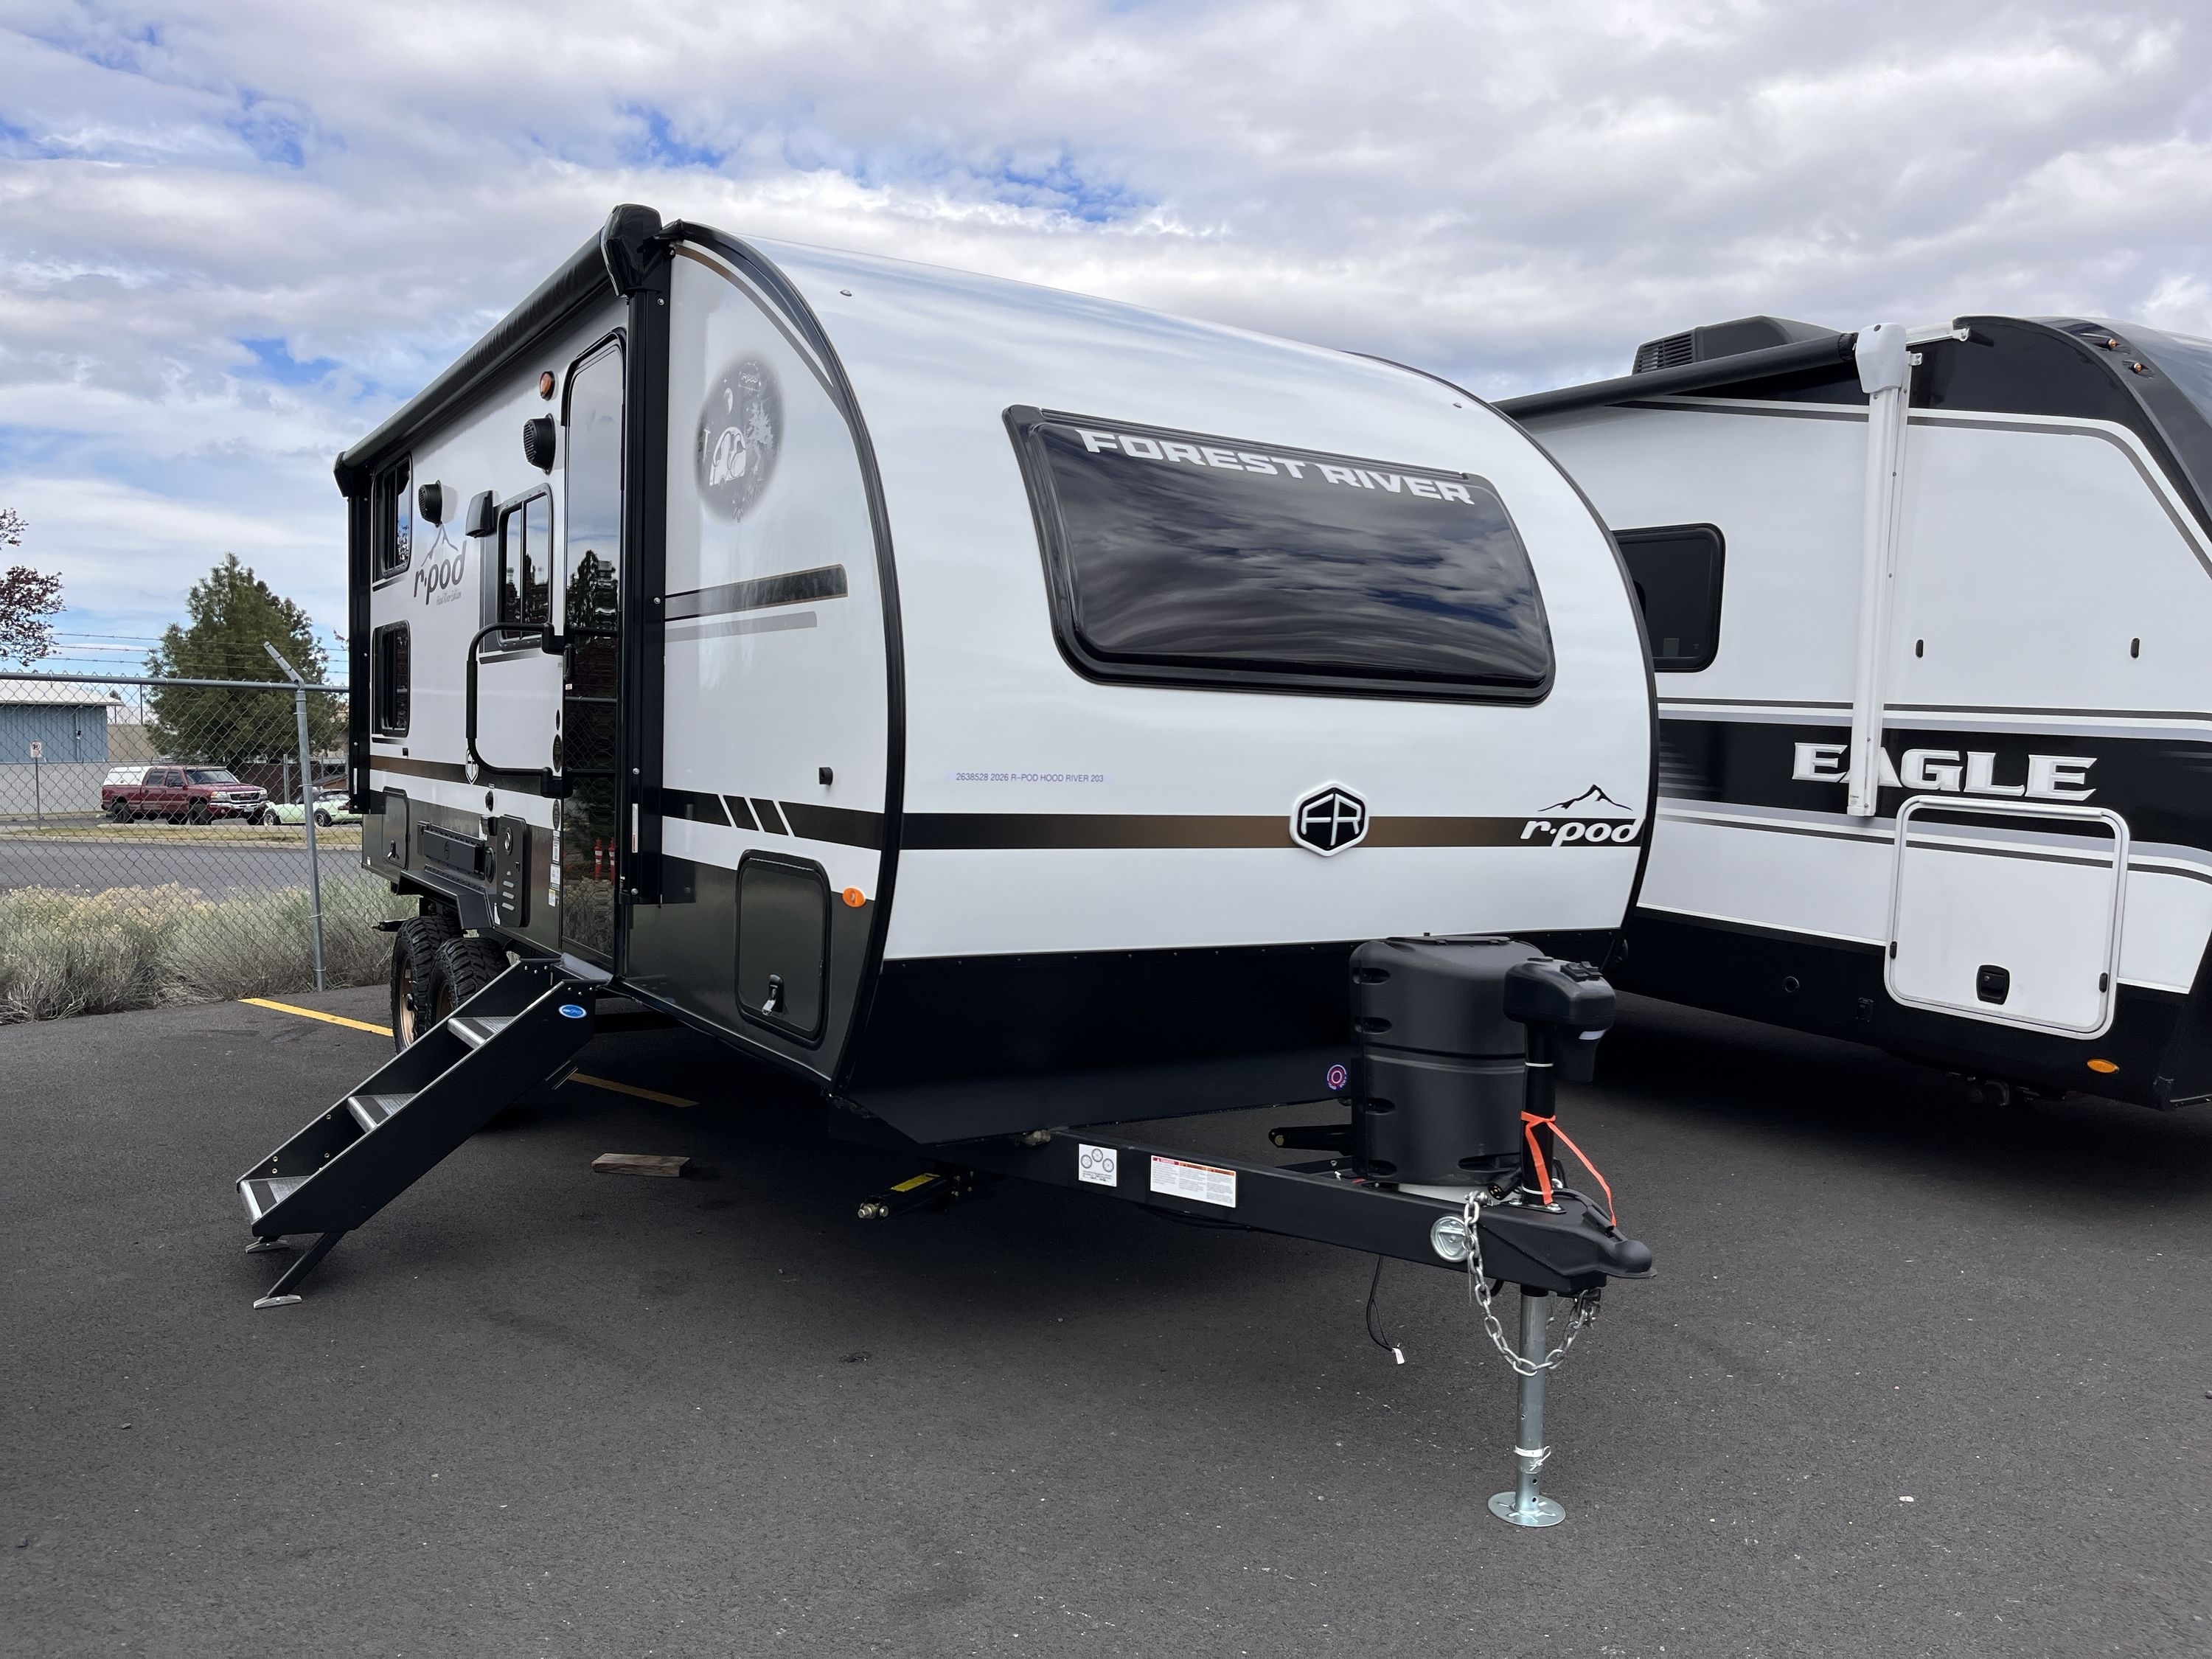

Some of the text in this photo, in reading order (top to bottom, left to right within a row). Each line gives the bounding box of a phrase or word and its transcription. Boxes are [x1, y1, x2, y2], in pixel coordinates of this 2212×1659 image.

[1075, 429, 1475, 505] FOREST RIVER
[956, 773, 989, 781] 2638528
[990, 773, 1009, 782] 2026
[1011, 773, 1038, 782] R-POD
[1065, 774, 1088, 782] RIVER
[1091, 774, 1103, 782] 203
